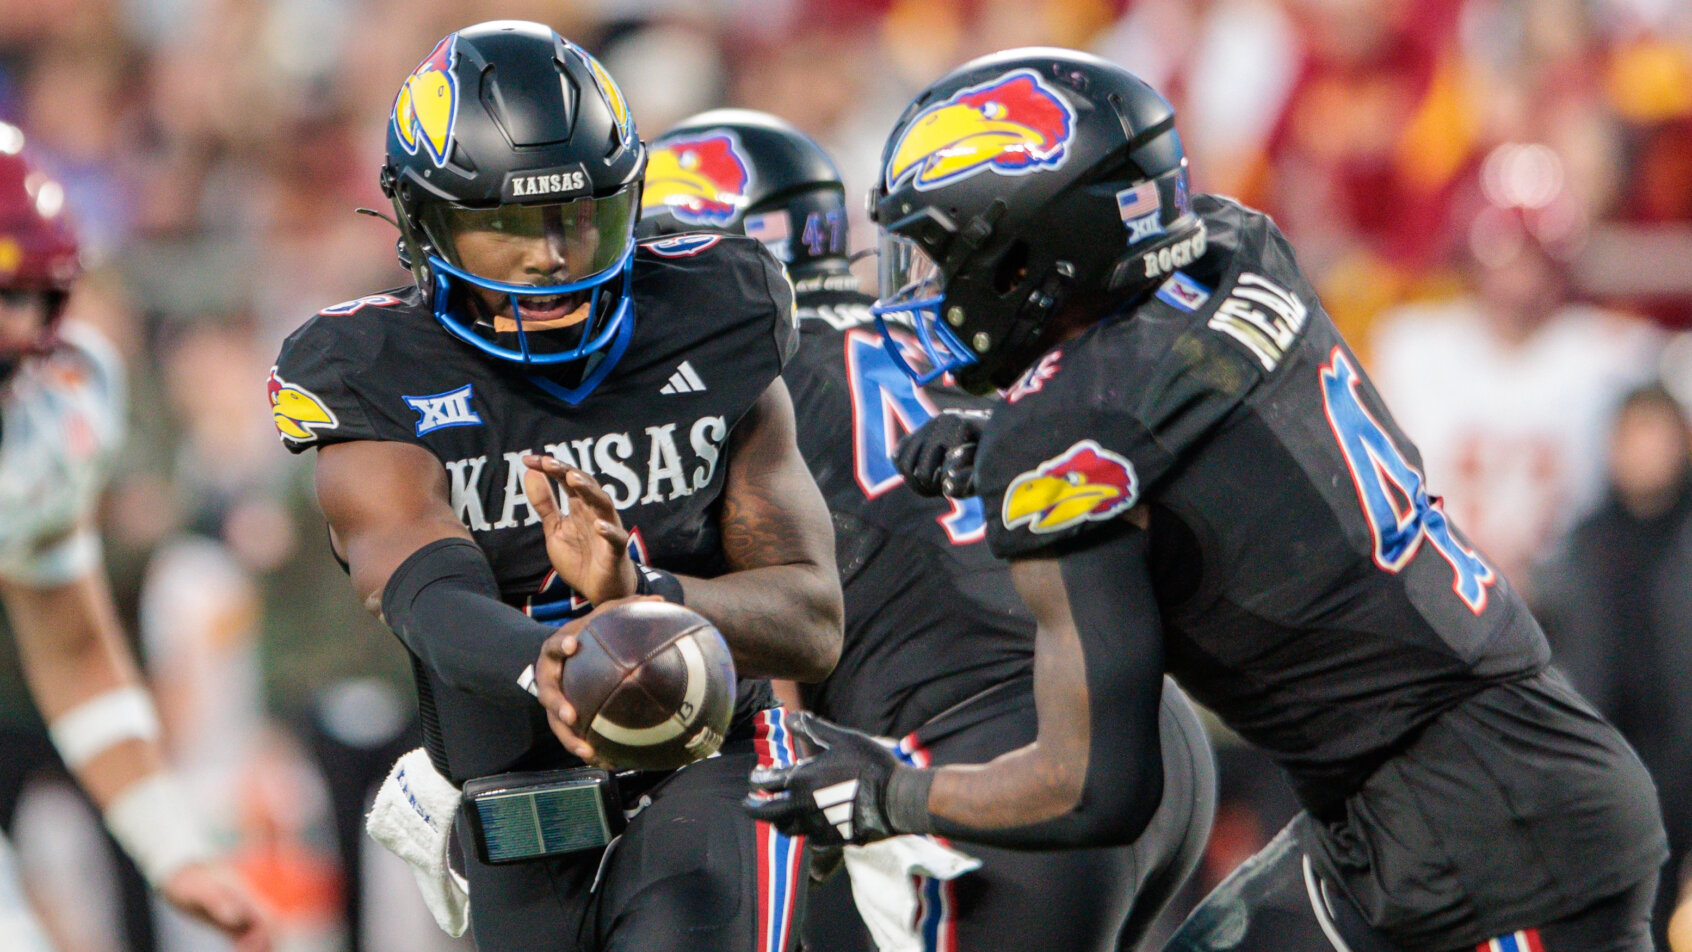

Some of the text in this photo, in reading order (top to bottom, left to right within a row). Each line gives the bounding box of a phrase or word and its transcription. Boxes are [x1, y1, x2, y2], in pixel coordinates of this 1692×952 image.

[511, 171, 585, 197] KANSAS
[801, 207, 848, 256] 47
[1207, 271, 1308, 373] NEAL
[401, 382, 484, 438] XII
[446, 415, 727, 532] KANSAS
[1317, 344, 1497, 617] 4
